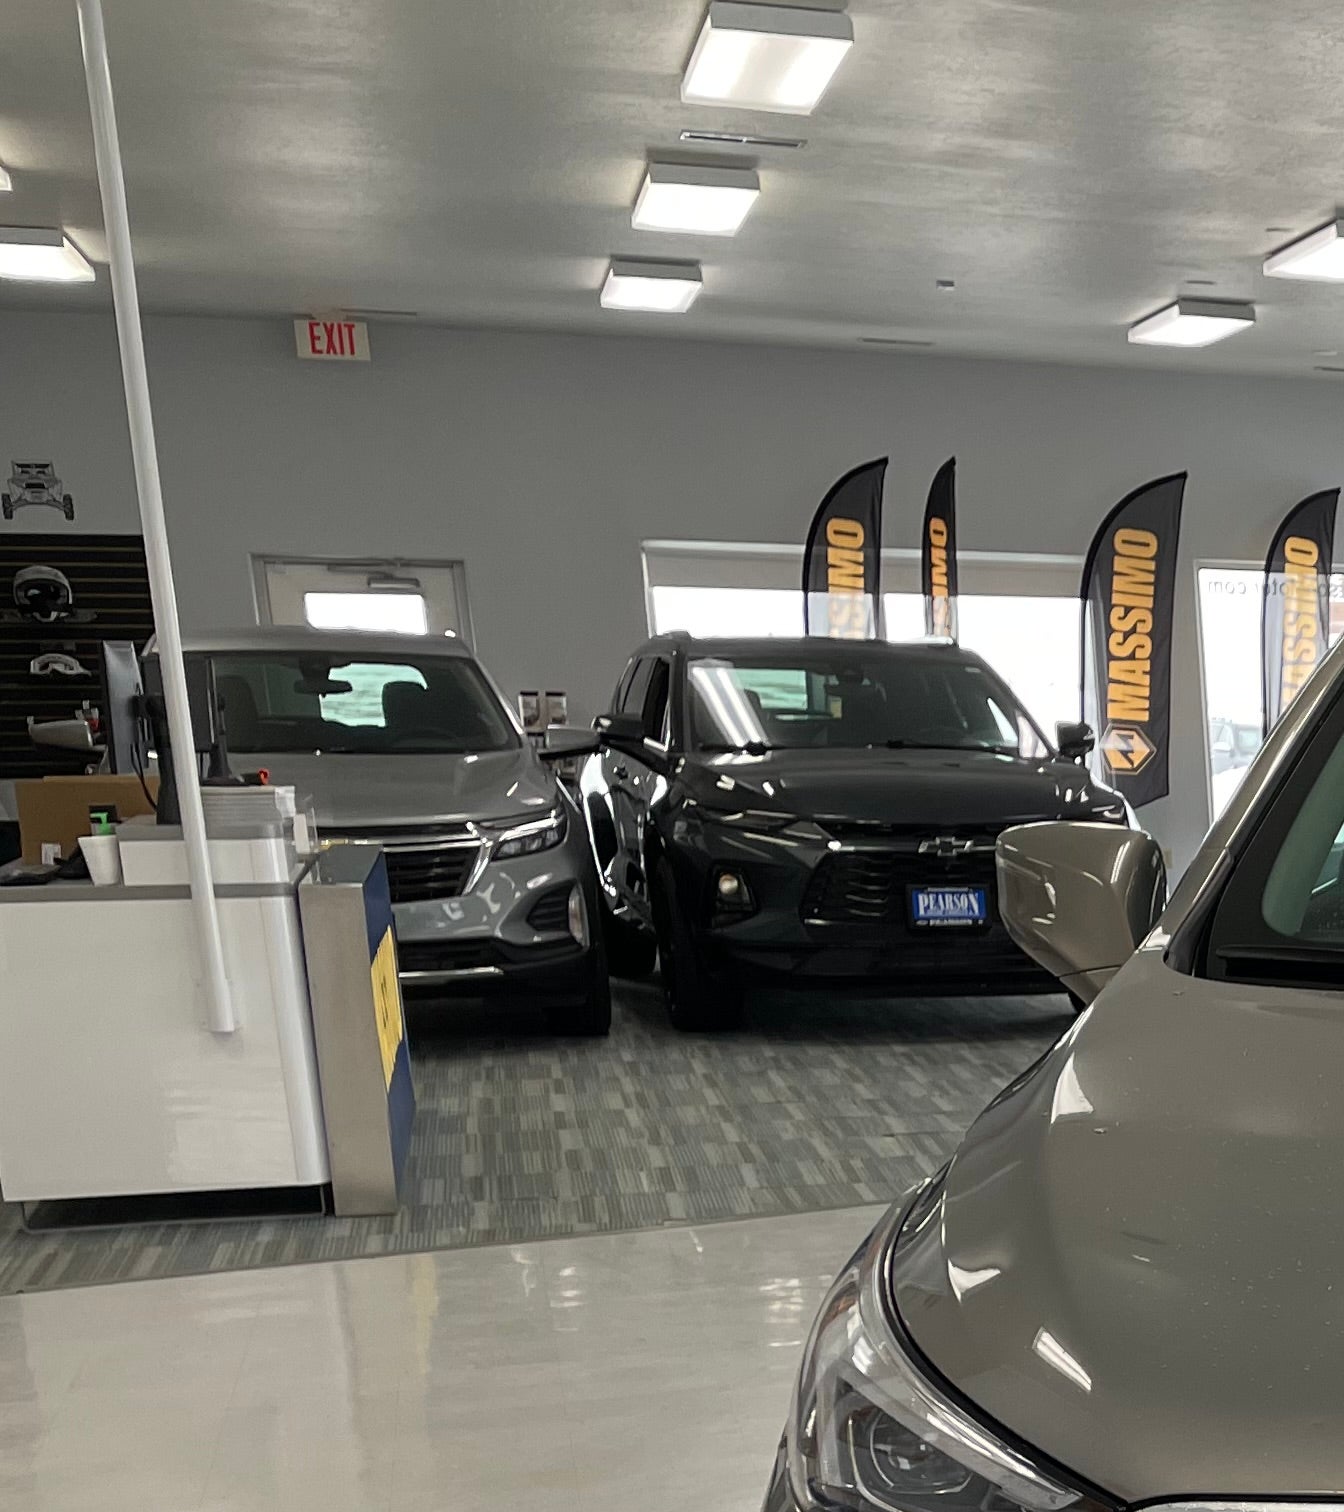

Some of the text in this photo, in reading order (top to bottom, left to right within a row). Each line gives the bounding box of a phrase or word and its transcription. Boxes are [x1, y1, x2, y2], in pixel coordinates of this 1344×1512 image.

[307, 321, 356, 356] EXIT
[1106, 527, 1159, 722] MASSIMO
[917, 892, 980, 917] PEARSON
